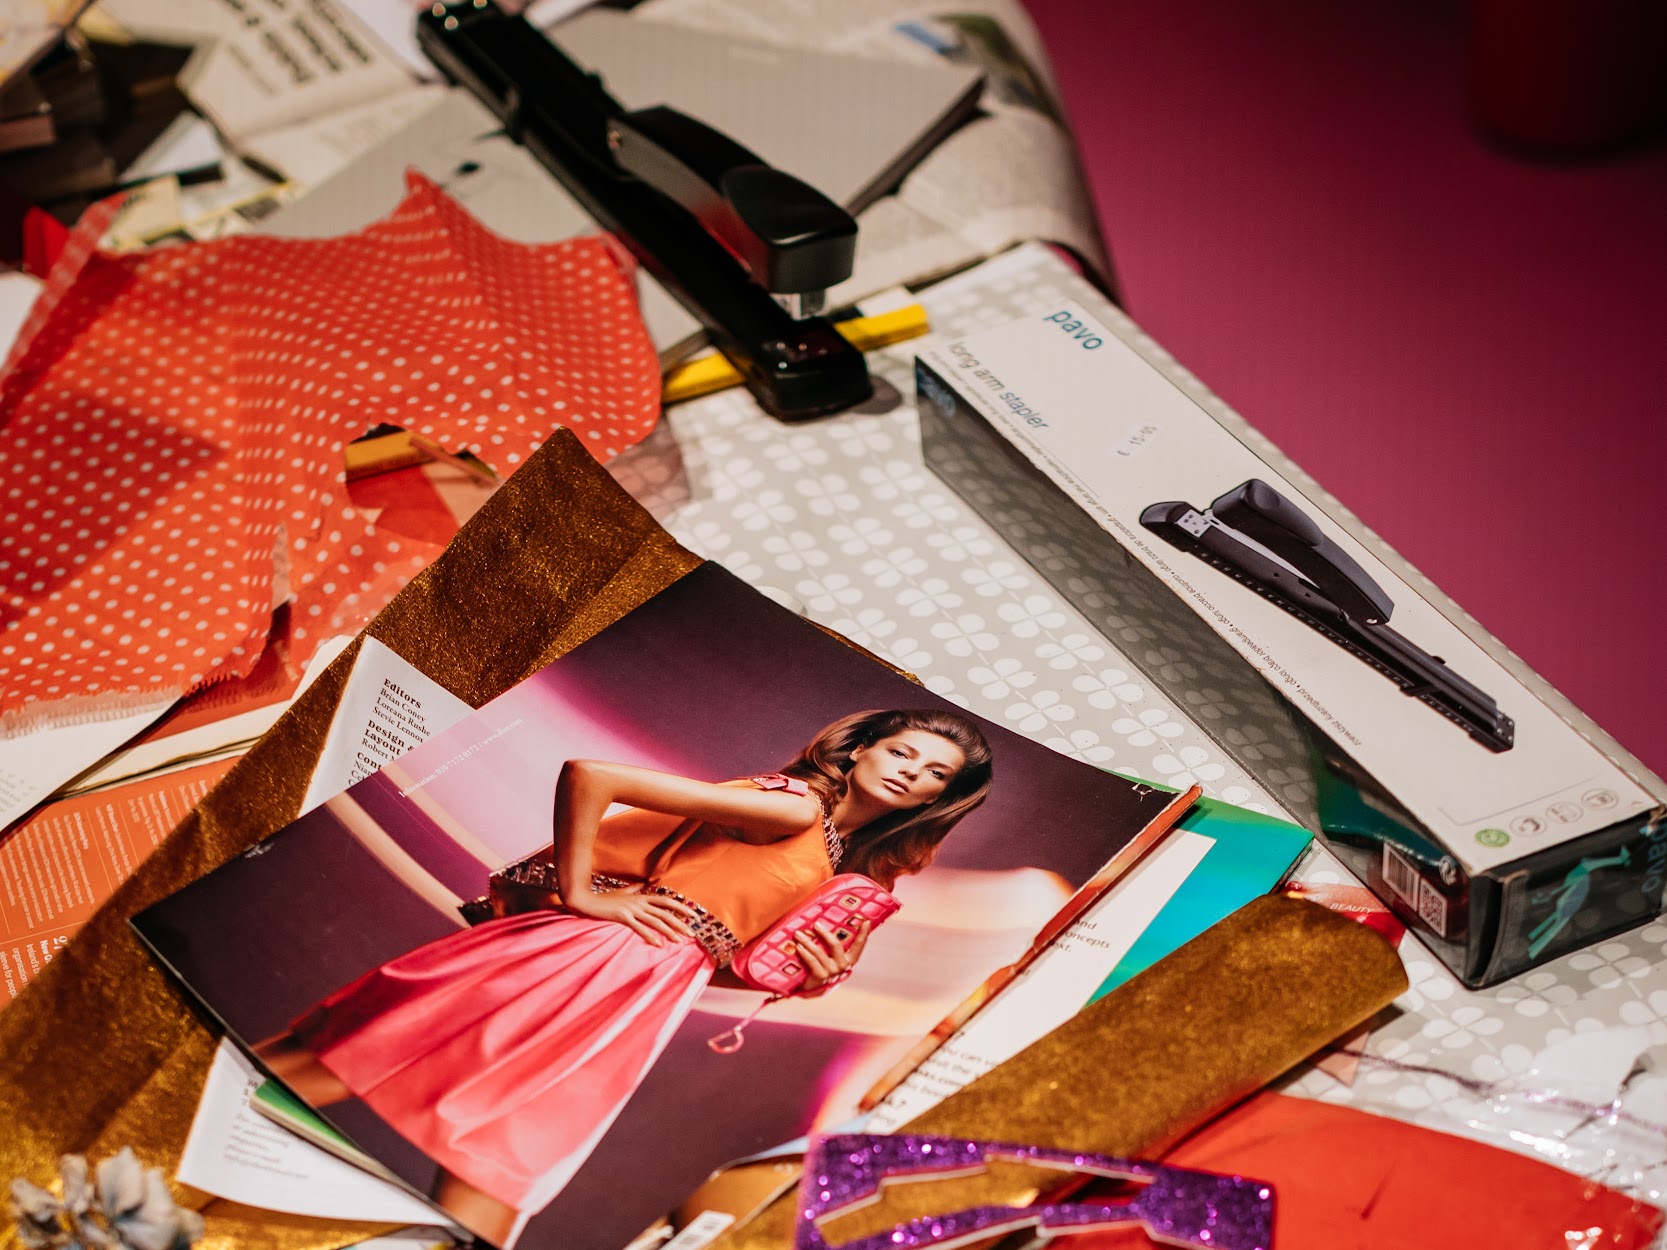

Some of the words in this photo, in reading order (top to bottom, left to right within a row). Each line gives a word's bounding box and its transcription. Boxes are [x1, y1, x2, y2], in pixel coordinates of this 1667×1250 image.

[1043, 310, 1104, 350] pavo
[949, 341, 980, 370] long
[974, 370, 1005, 391] arm
[1000, 392, 1049, 429] stapler
[1141, 545, 1158, 560] brazo
[1193, 591, 1215, 611] braccio
[1213, 609, 1230, 627] lungo
[1229, 625, 1266, 657] grampeador
[1263, 654, 1281, 674] braço
[1279, 667, 1297, 686] longo
[380, 687, 400, 707] Brian
[401, 703, 426, 723] Coney
[383, 678, 421, 709] Editors
[367, 719, 405, 748] Design
[372, 706, 395, 725] Stevie
[396, 722, 424, 743] Lennox
[361, 738, 389, 759] Robert
[364, 728, 401, 756] Layout
[398, 771, 438, 798] Information:
[435, 763, 449, 776] 020
[447, 754, 464, 768] 7172
[462, 745, 480, 758] 0172
[482, 718, 523, 746] www.dior.com
[1330, 902, 1374, 913] BEAUTY
[40, 939, 49, 955] New
[1065, 931, 1110, 948] oncepts
[12, 947, 28, 983] organisation
[26, 943, 40, 968] Ireland's
[5, 969, 13, 979] for
